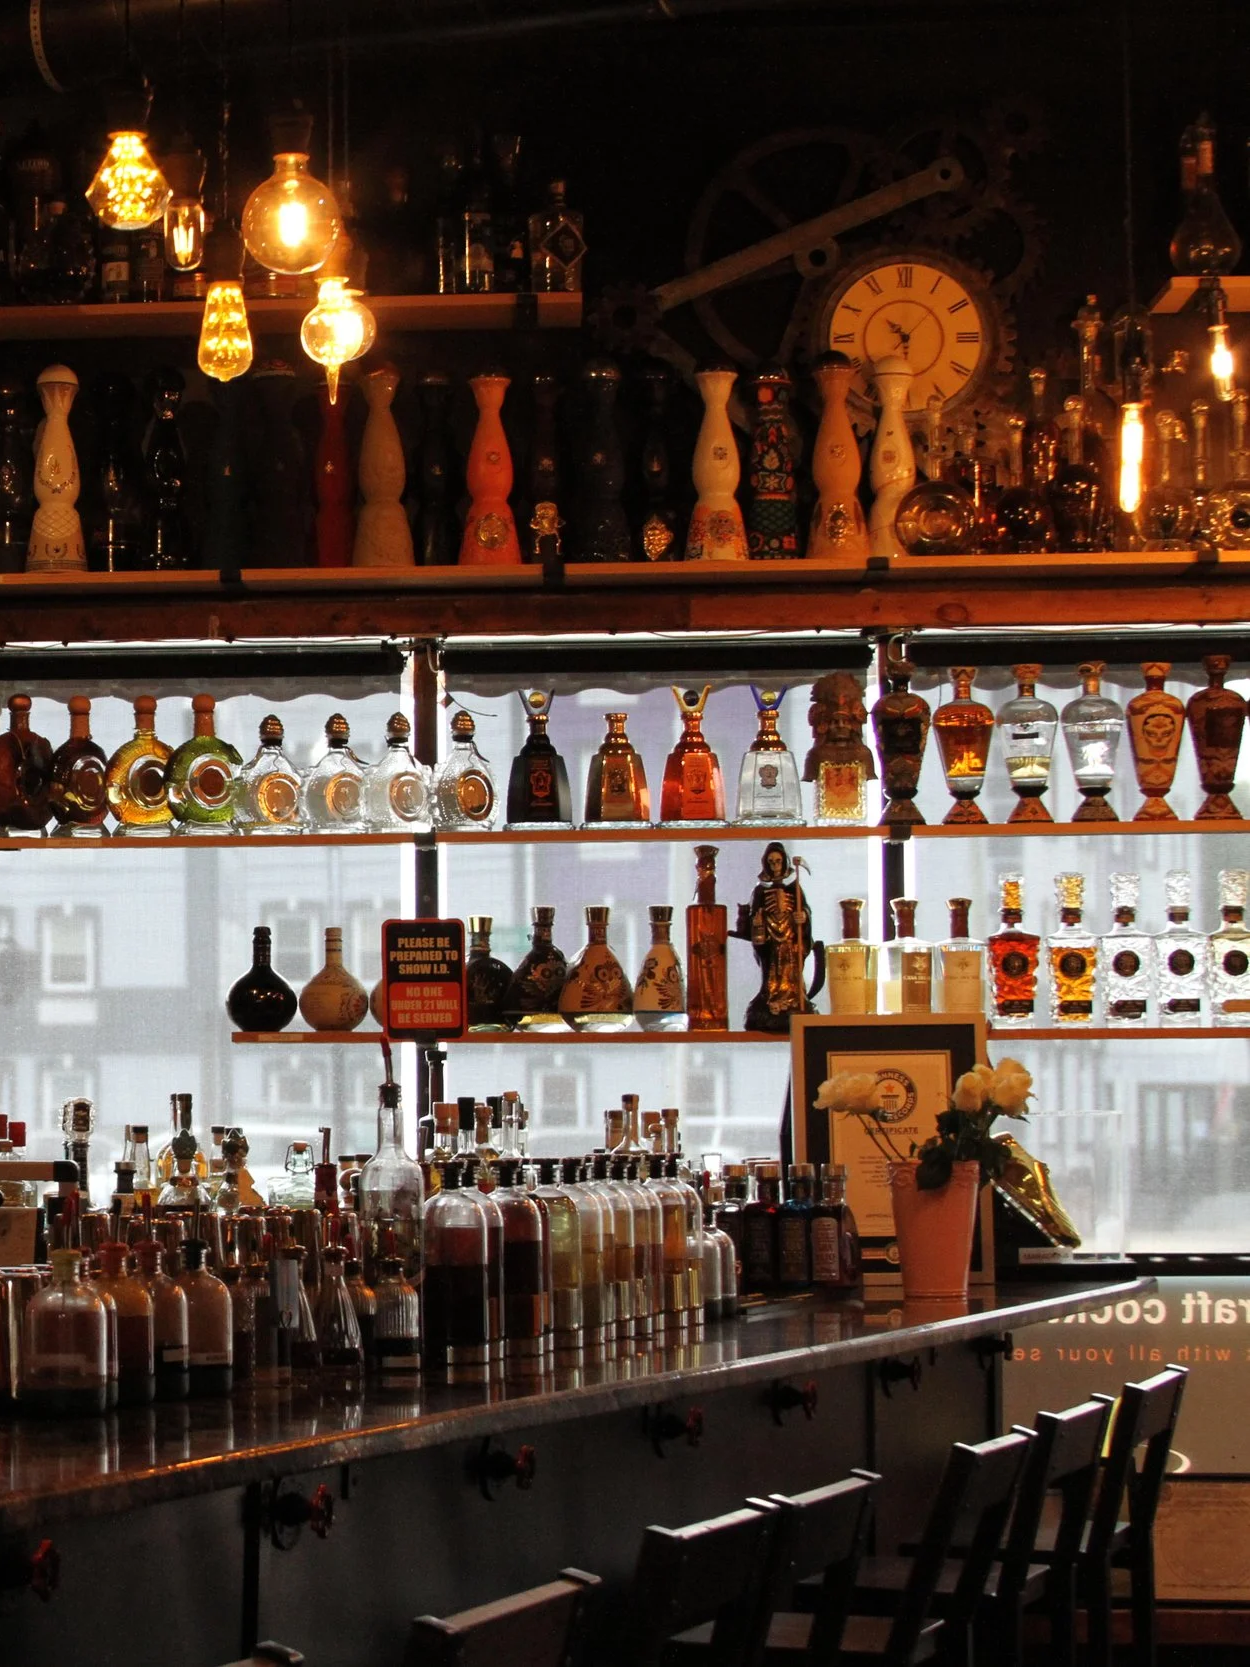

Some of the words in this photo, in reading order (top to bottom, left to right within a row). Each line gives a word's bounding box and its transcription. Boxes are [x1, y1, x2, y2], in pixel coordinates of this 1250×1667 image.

[397, 937, 434, 948] PLEASE
[436, 937, 450, 948] BE
[390, 950, 442, 961] PREPARED
[444, 950, 458, 961] TO
[398, 963, 431, 975] SHOW
[433, 963, 450, 975] I.D.
[406, 986, 421, 997] NO
[423, 986, 443, 997] ONE
[391, 1000, 422, 1010] UNDER
[424, 1000, 435, 1010] 21
[436, 1000, 458, 1010] WILL
[398, 1013, 411, 1024] BE
[413, 1013, 452, 1024] SERVED
